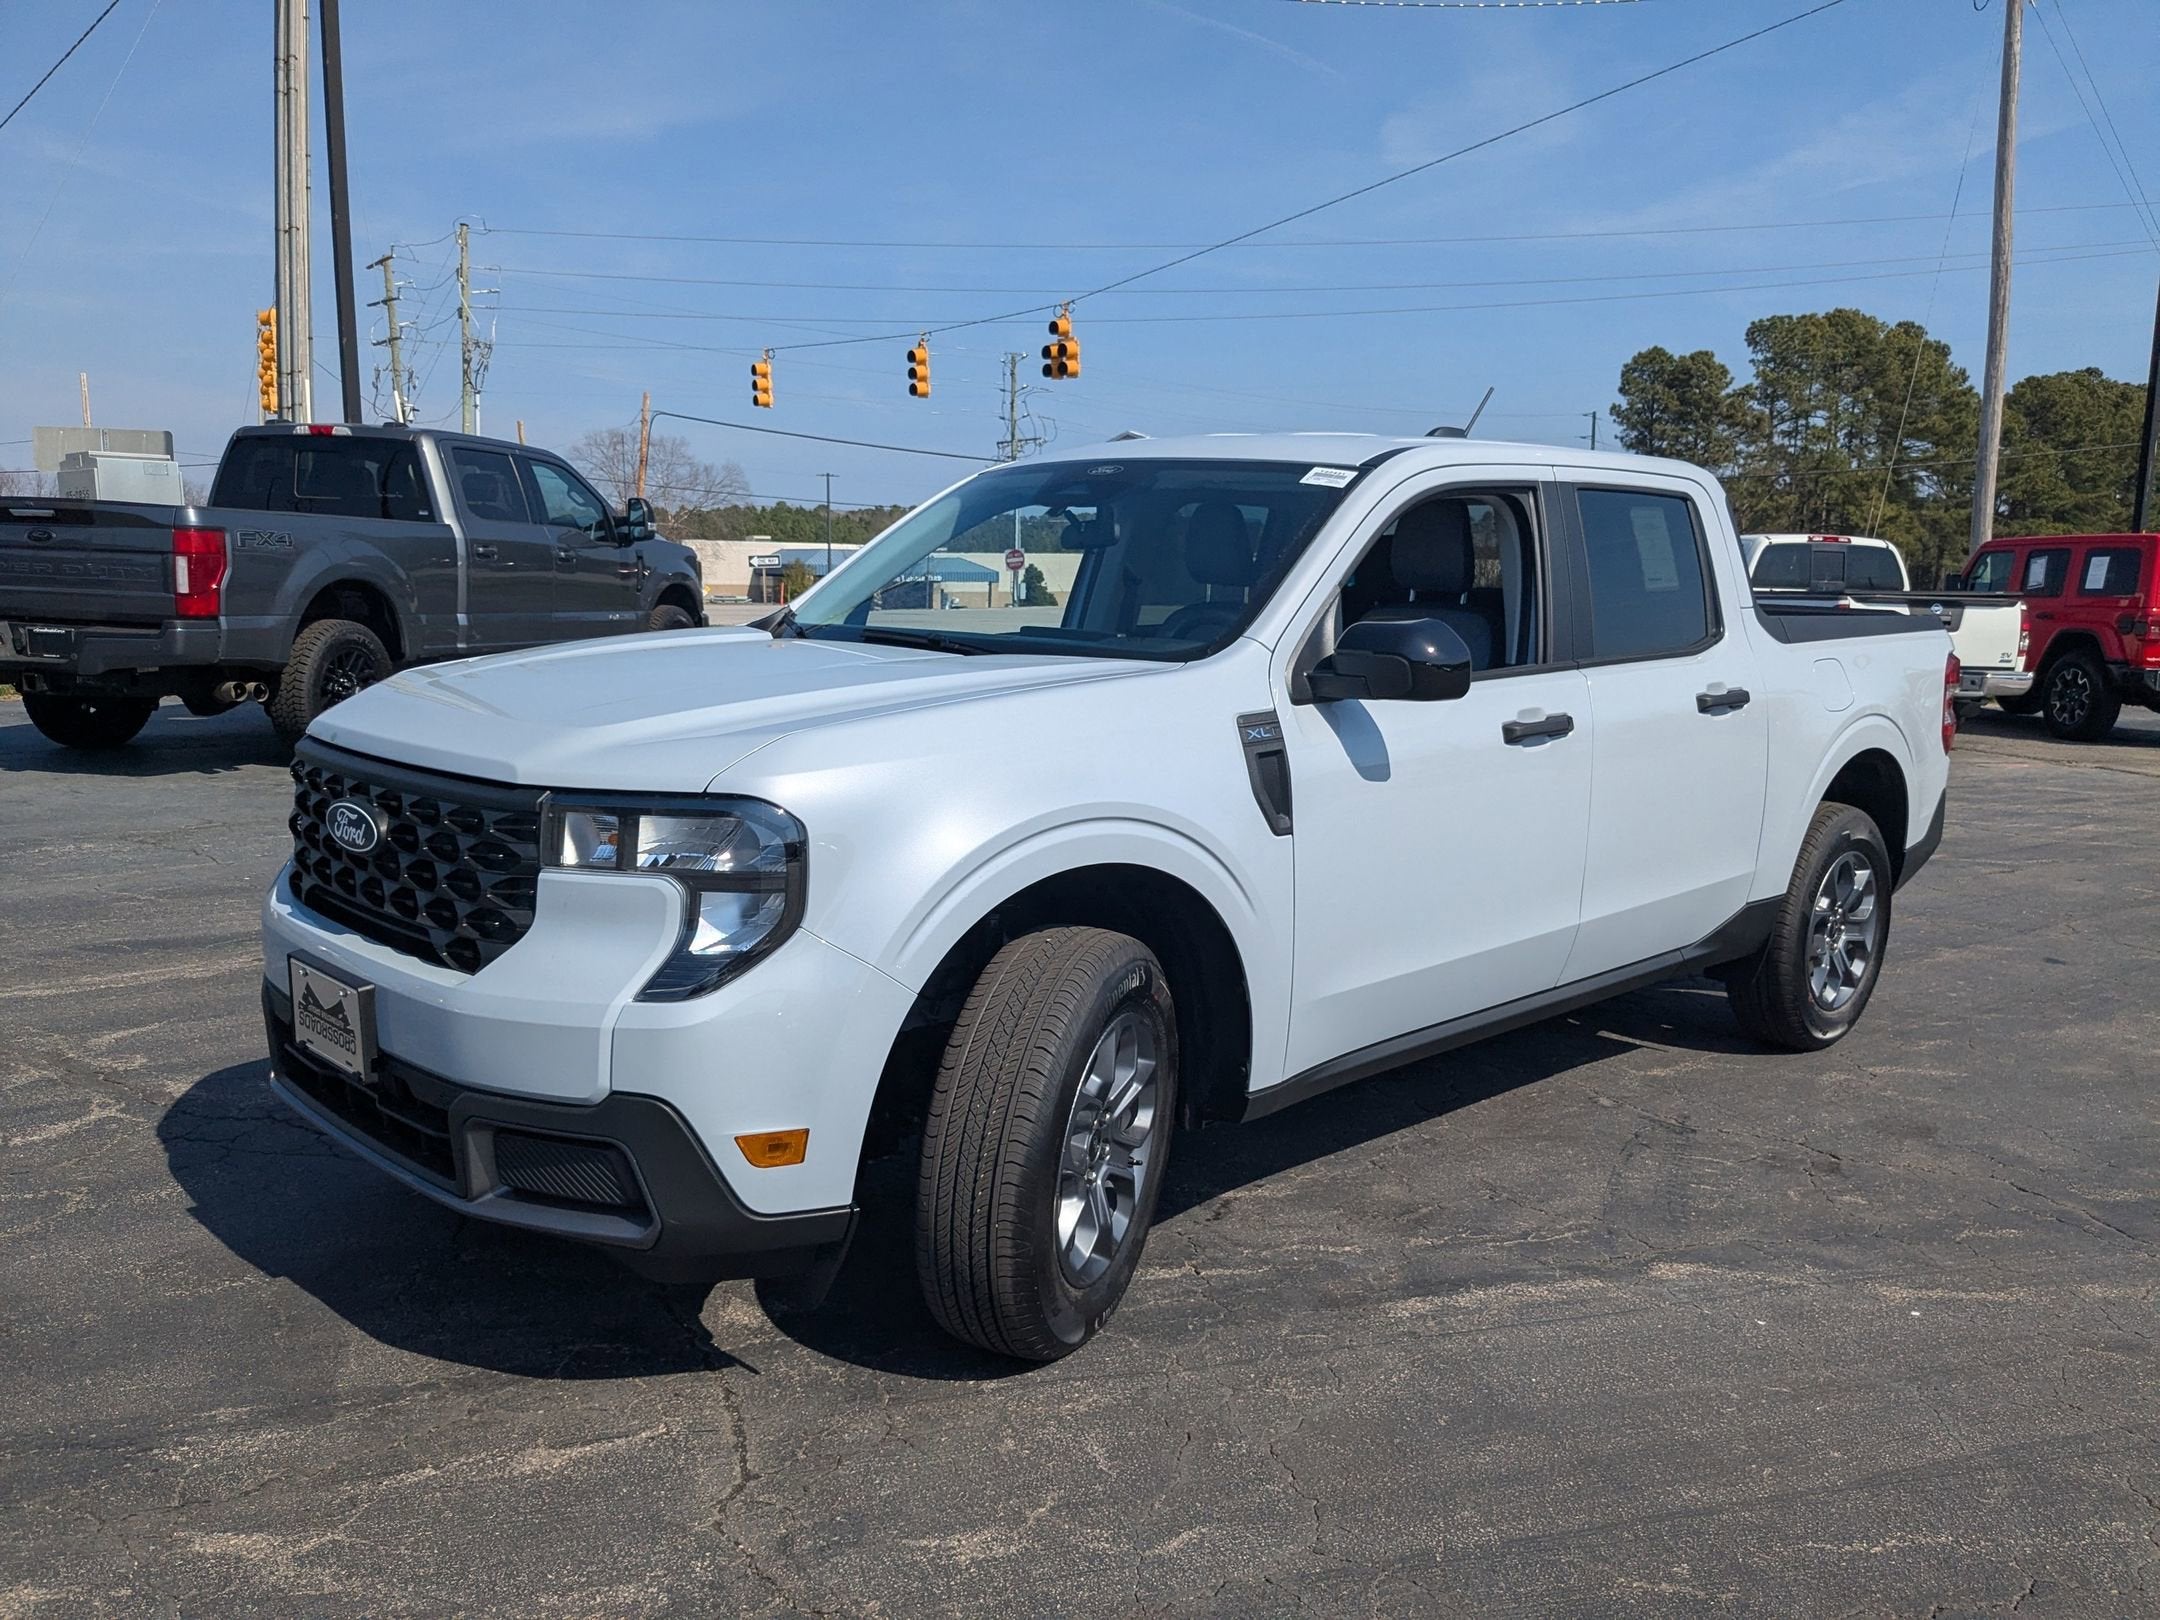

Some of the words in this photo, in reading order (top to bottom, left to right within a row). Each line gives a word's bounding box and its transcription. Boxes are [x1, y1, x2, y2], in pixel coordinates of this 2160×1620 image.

[235, 528, 295, 549] FX4
[334, 807, 367, 847] Ford
[298, 1010, 358, 1056] CROSSROADS
